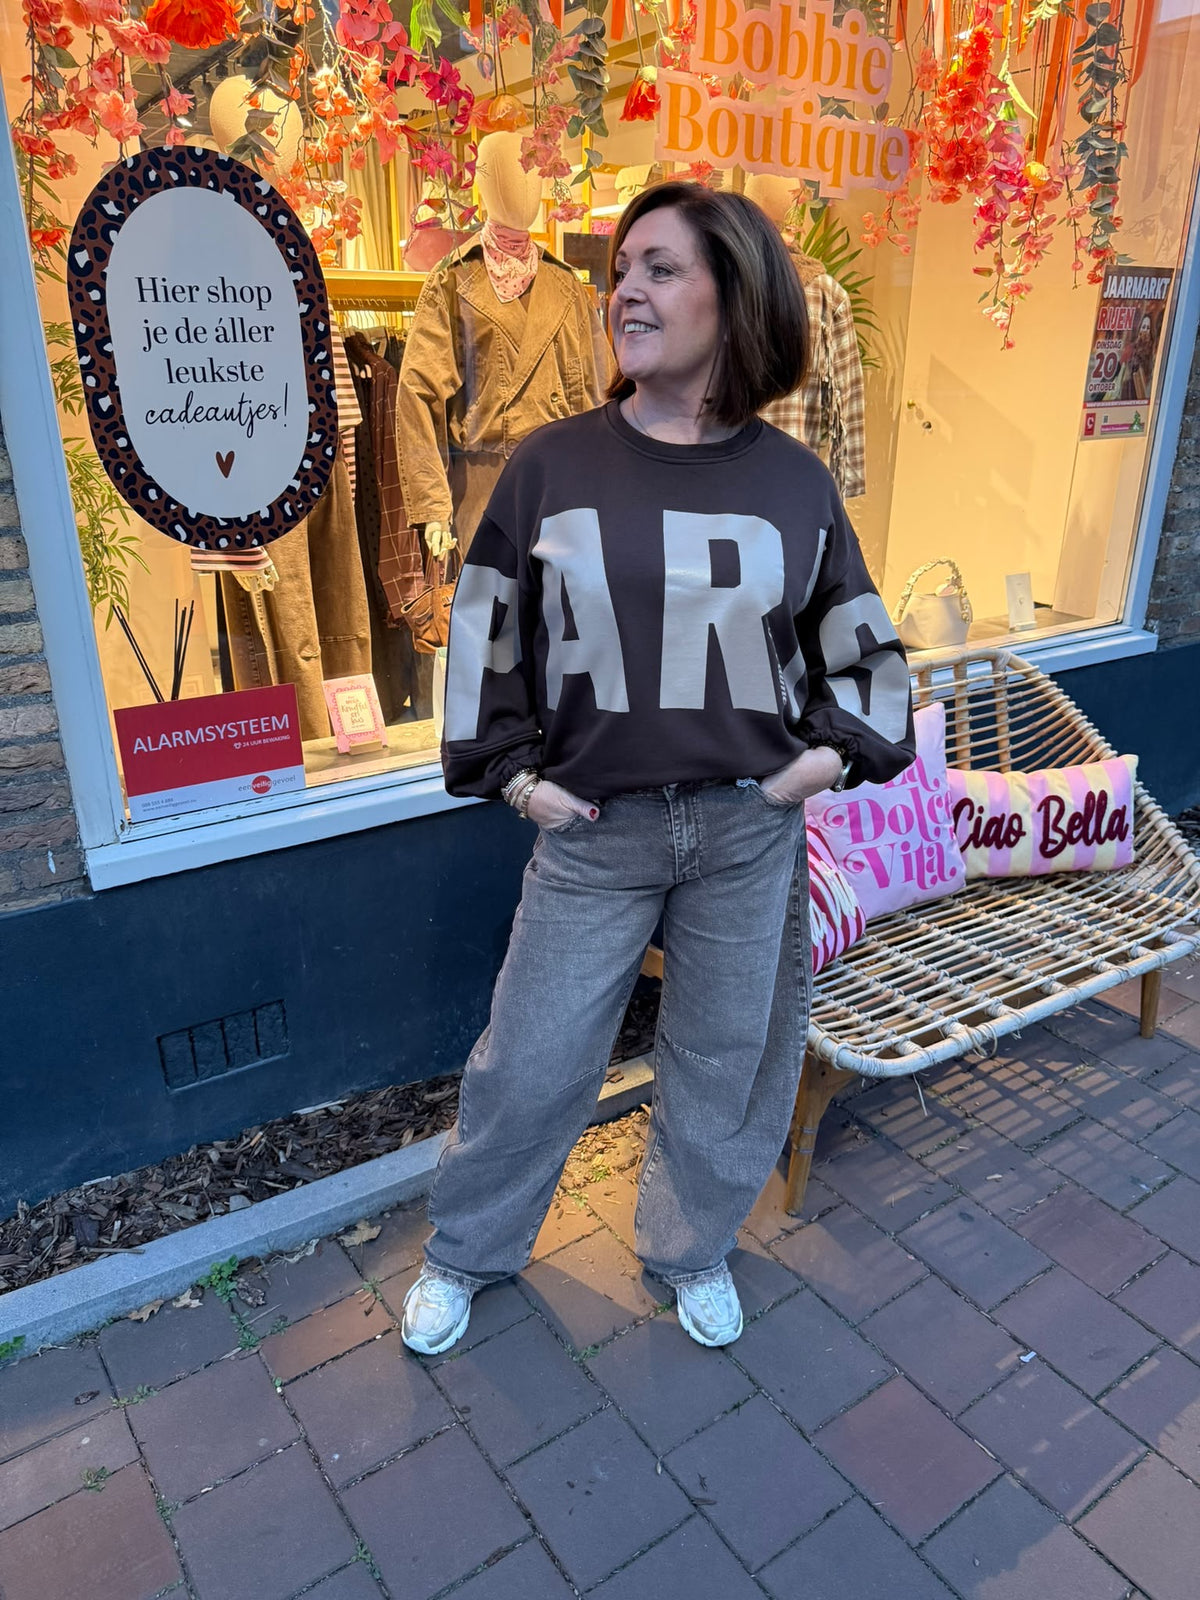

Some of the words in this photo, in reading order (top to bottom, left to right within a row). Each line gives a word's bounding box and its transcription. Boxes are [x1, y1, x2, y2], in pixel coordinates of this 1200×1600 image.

[700, 0, 887, 95] Bobbie
[664, 81, 903, 188] Boutique
[134, 276, 200, 303] Hier
[206, 276, 272, 311] shop
[1103, 275, 1171, 300] JAARMARKT
[142, 319, 168, 352] je
[175, 317, 208, 344] de
[214, 317, 275, 343] áller
[1097, 306, 1136, 332] RIJEN
[1095, 340, 1122, 350] DINSDAG
[164, 357, 265, 384] leukste
[1091, 351, 1118, 379] 20
[1088, 382, 1116, 392] OKTOBER
[145, 382, 288, 438] cadeautjes!
[133, 713, 290, 755] ALARMSYSTEEM
[953, 797, 1026, 853] Ciao
[1037, 789, 1130, 859] Bella
[842, 840, 958, 891] Vita
